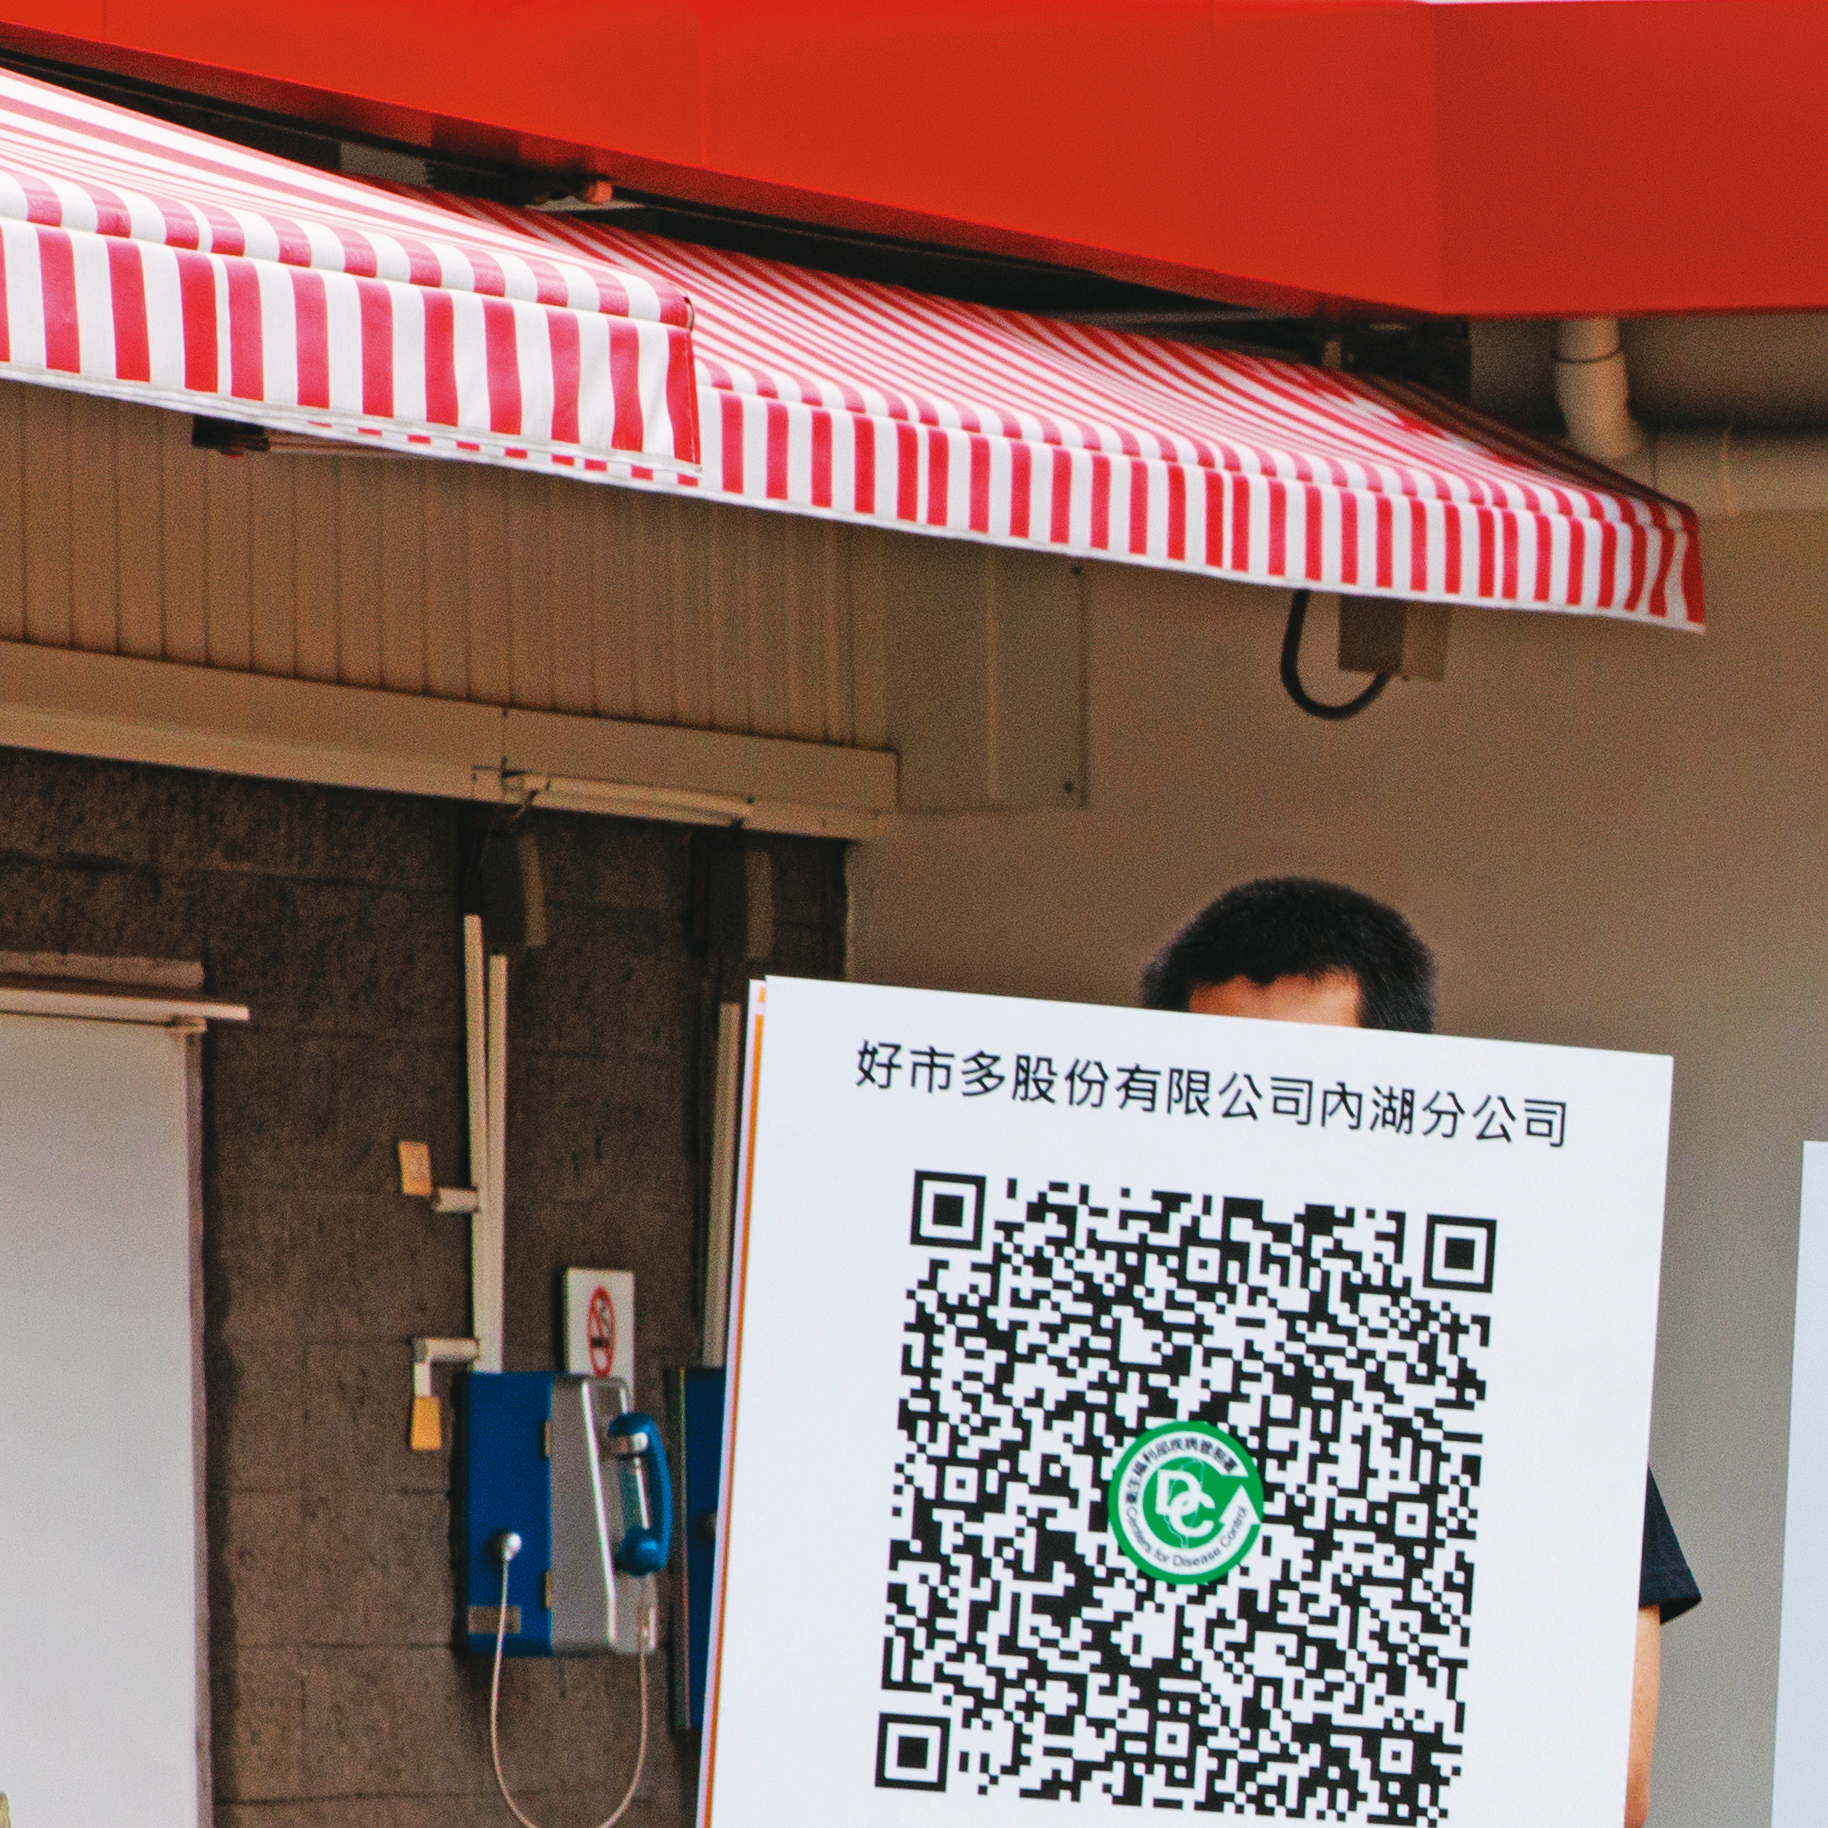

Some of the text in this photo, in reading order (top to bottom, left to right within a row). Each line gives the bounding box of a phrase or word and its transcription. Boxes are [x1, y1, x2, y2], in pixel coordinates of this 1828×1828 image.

[855, 1039, 1568, 1149] 好市多股份有限公司內湖分公司
[1172, 1547, 1222, 1568] Disease
